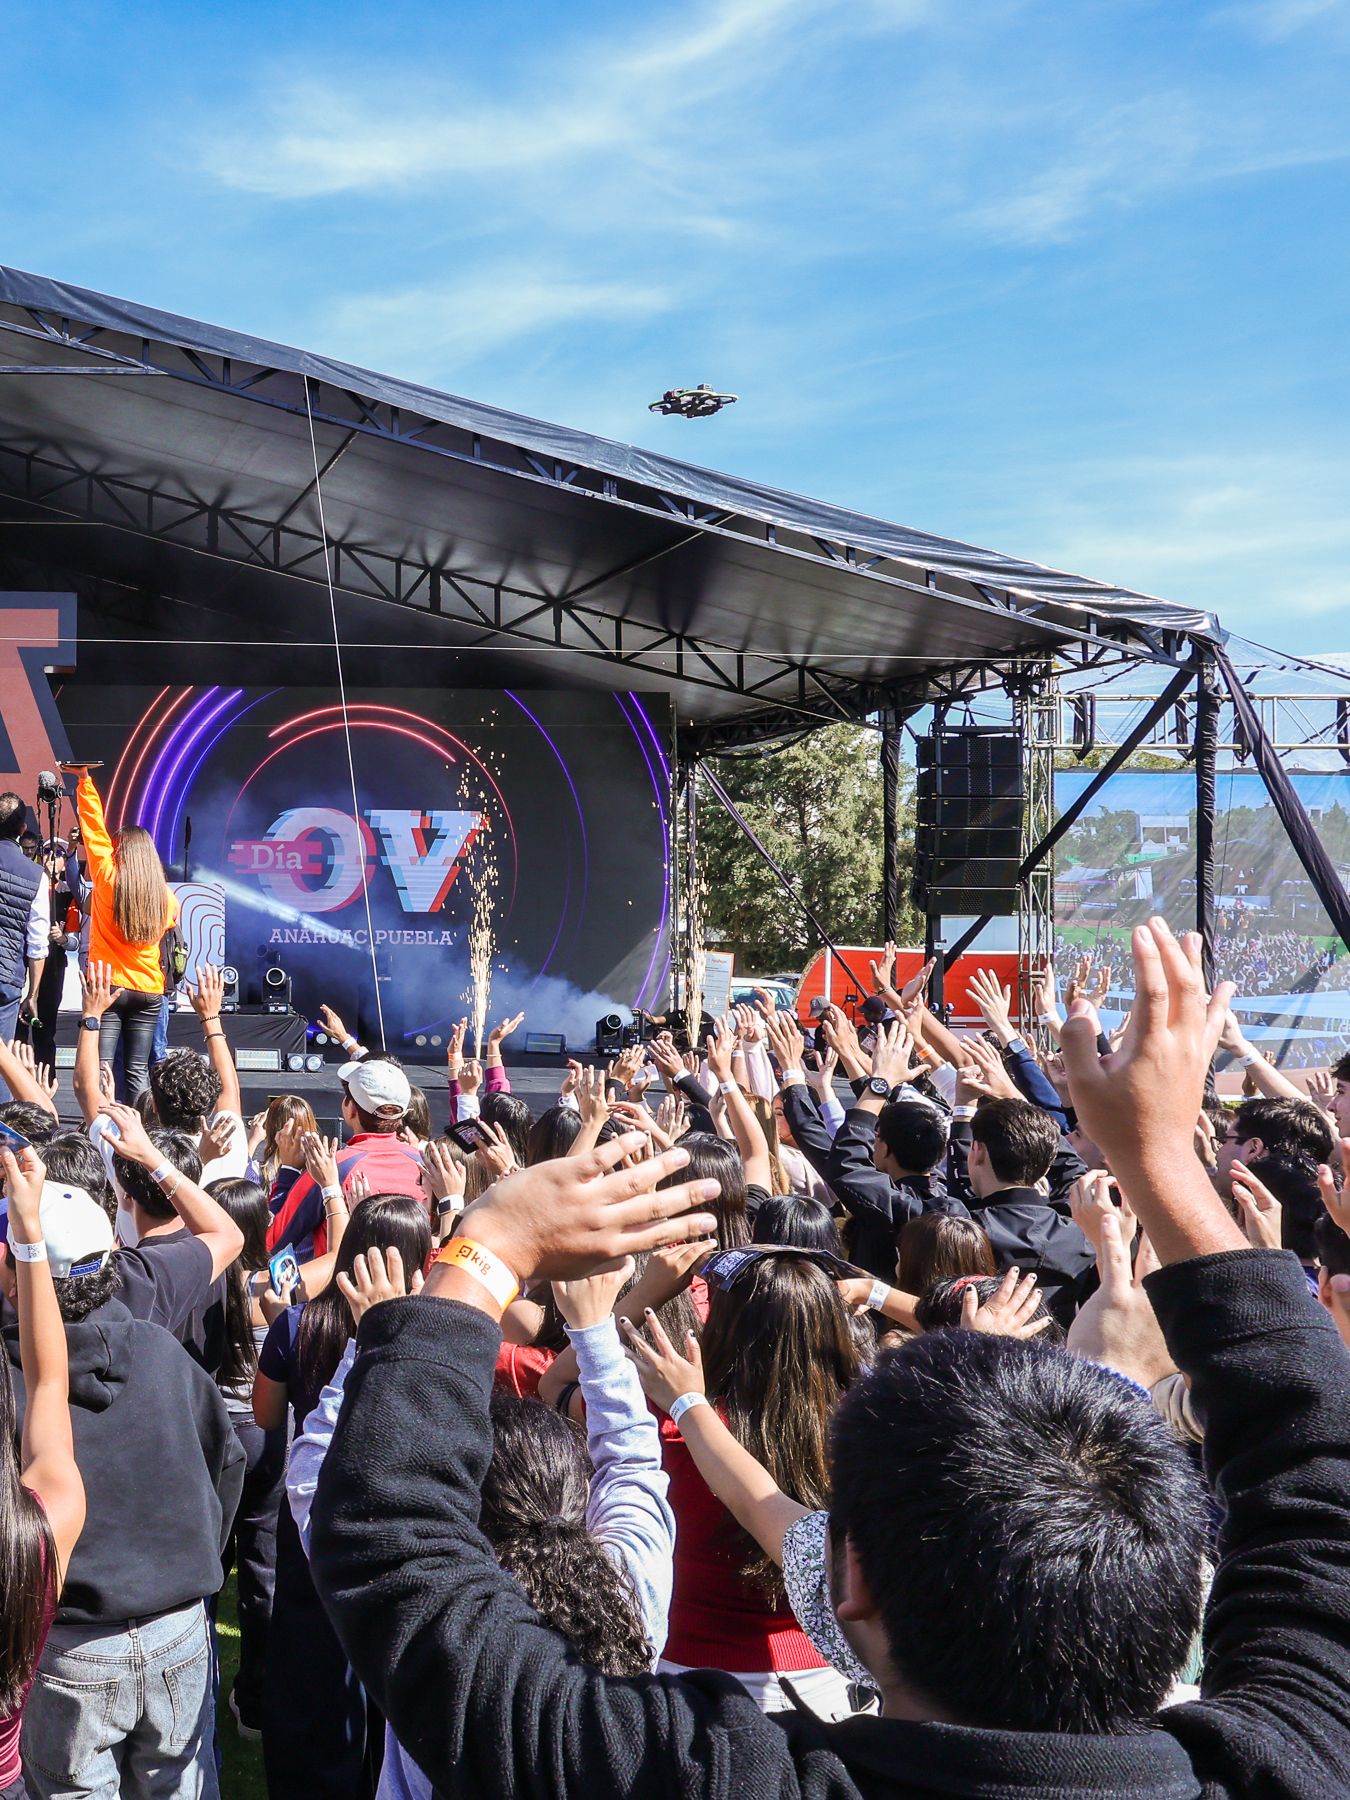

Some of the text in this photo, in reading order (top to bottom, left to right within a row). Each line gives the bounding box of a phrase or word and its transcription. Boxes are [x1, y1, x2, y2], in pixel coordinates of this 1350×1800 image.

[250, 844, 303, 870] Día
[258, 807, 491, 912] OV
[375, 930, 453, 945] PUEBLA
